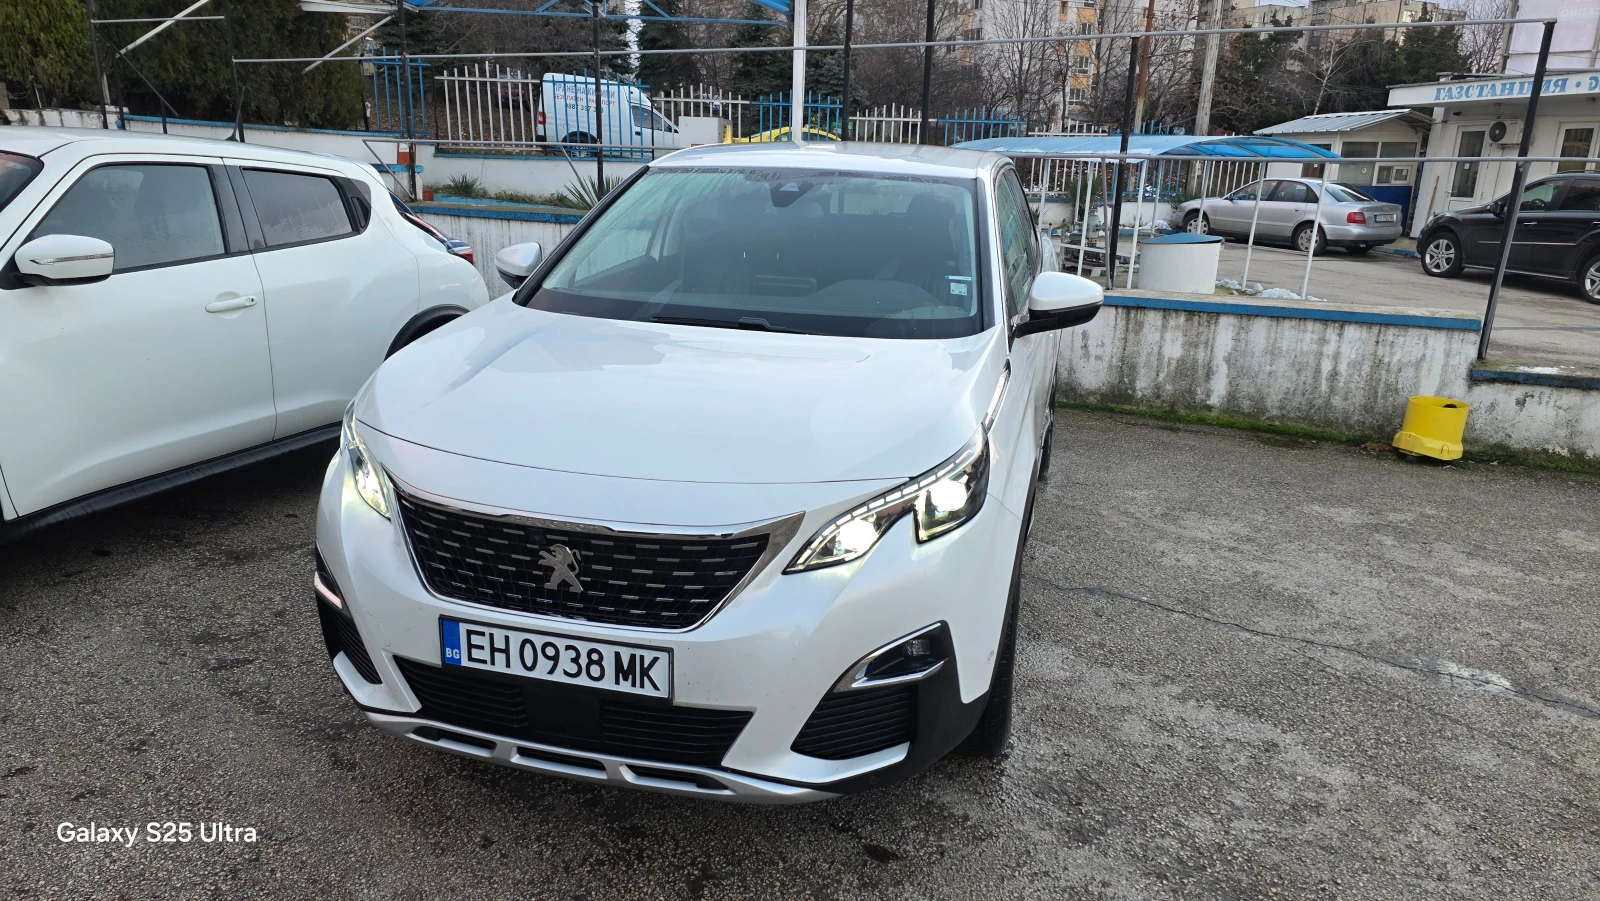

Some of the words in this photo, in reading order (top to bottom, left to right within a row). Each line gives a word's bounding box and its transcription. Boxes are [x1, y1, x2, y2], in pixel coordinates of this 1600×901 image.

[1433, 77, 1569, 101] ГАЗСТАНЦИЯ
[445, 647, 460, 660] BG
[466, 628, 511, 669] EH
[518, 637, 606, 682] 0938
[614, 650, 661, 691] MK
